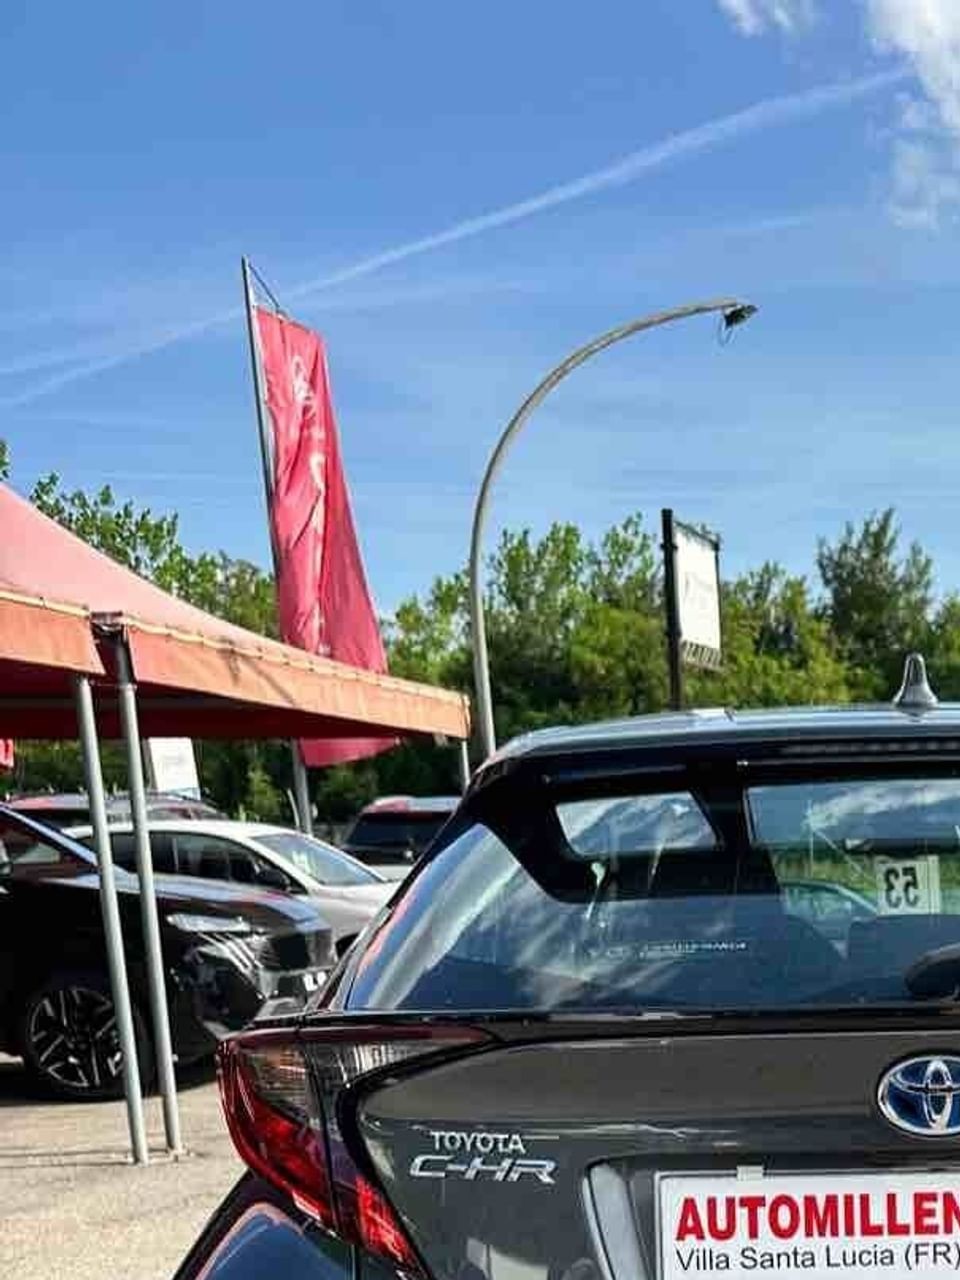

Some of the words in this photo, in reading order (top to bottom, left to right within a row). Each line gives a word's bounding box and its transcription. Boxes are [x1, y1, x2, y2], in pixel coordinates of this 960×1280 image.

[430, 1130, 526, 1153] TOYOTA
[409, 1155, 556, 1184] C-HR
[674, 1248, 731, 1271] Villa
[739, 1248, 816, 1270] Santa
[825, 1243, 895, 1268] Lucia
